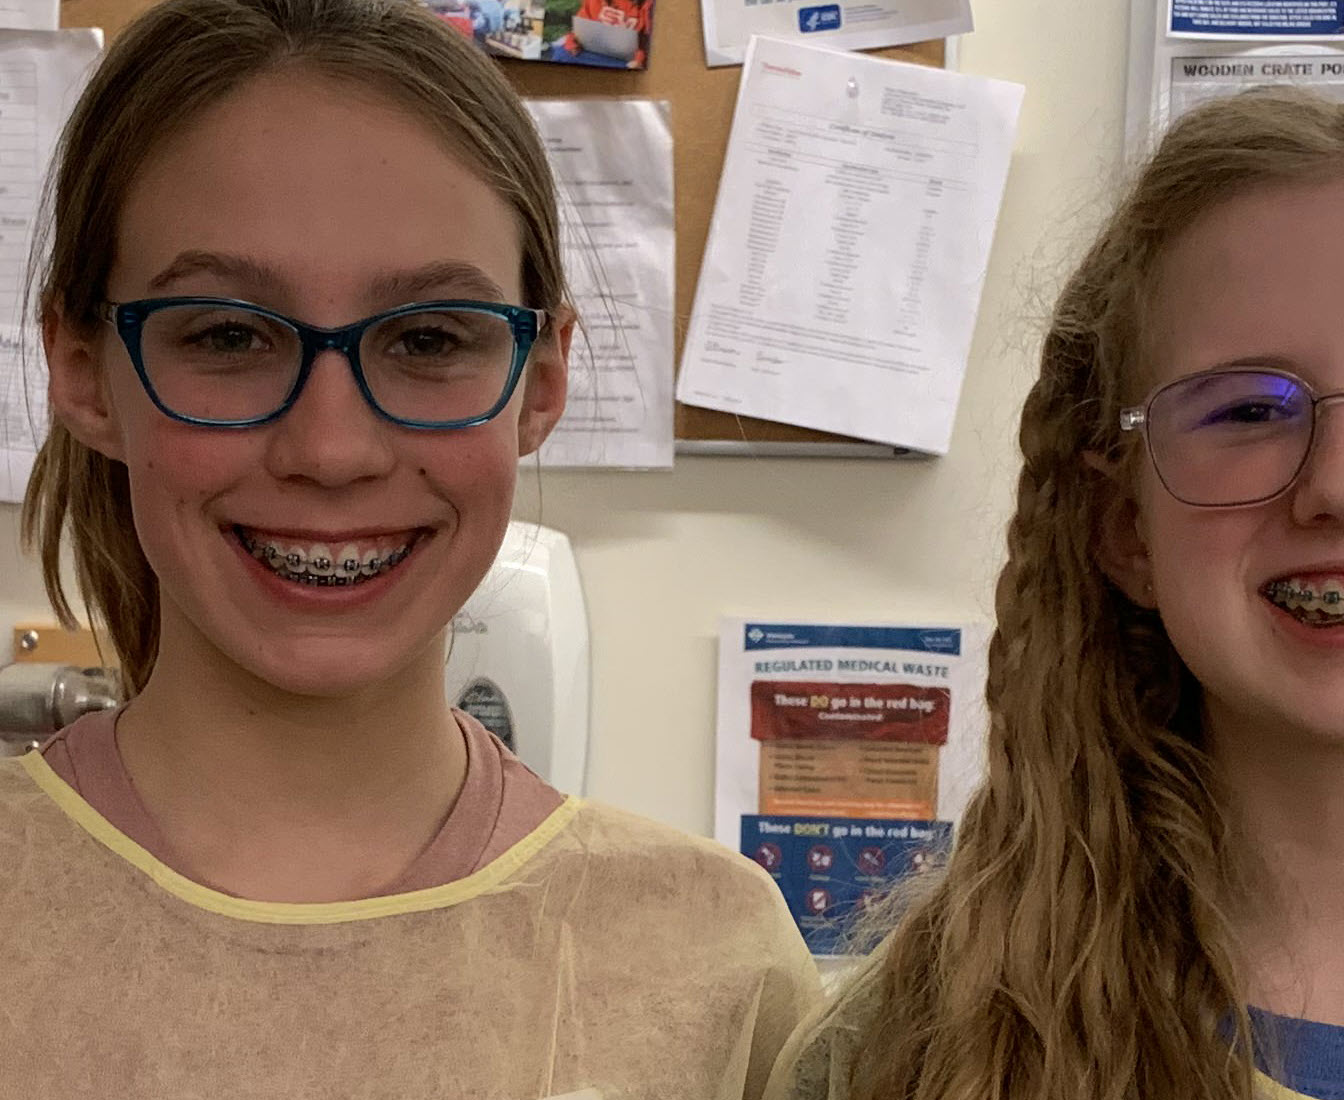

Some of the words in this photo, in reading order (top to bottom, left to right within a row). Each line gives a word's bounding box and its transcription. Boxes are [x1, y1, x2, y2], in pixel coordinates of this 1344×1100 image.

[1183, 63, 1254, 76] WOODEN
[1261, 63, 1312, 76] CRATE
[755, 660, 833, 673] REGULATED
[838, 659, 897, 673] MEDICAL
[903, 663, 949, 677] WASTE
[774, 694, 808, 706] These
[810, 695, 829, 708] DO
[830, 698, 847, 710] go
[849, 697, 861, 708] in
[864, 697, 884, 709] the
[886, 697, 906, 709] red
[759, 821, 791, 833] These
[832, 826, 848, 838] go
[850, 825, 862, 836] in
[865, 826, 885, 838] the
[887, 826, 908, 838] red
